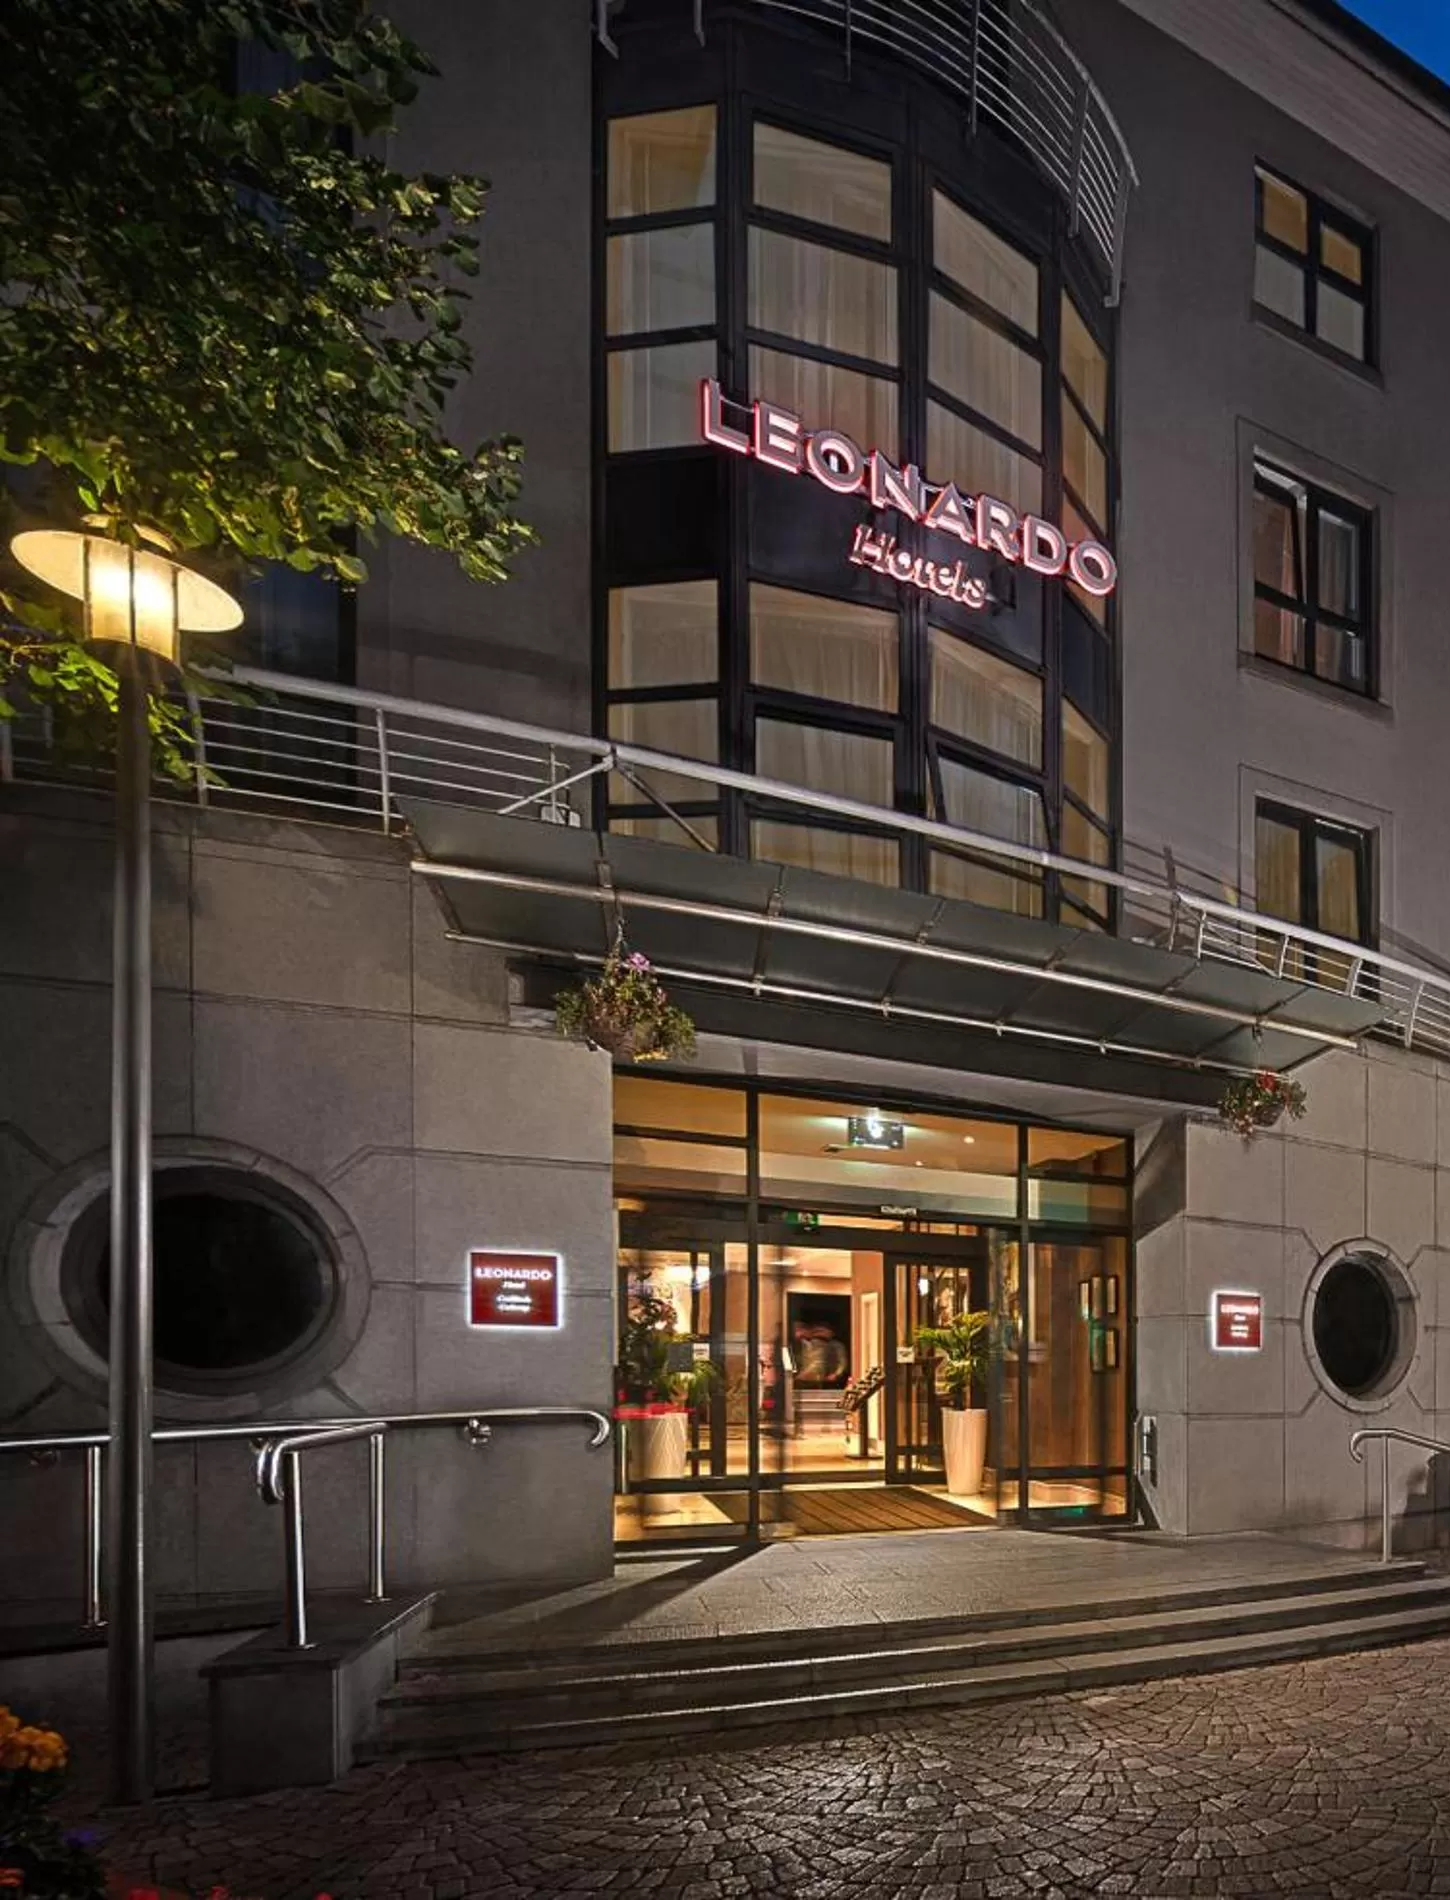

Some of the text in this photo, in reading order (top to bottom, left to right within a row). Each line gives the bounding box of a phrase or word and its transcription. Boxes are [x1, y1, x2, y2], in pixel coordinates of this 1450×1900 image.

[700, 378, 1117, 597] LEONARDO
[848, 523, 987, 609] Hotels
[474, 1266, 552, 1281] LEONARDO
